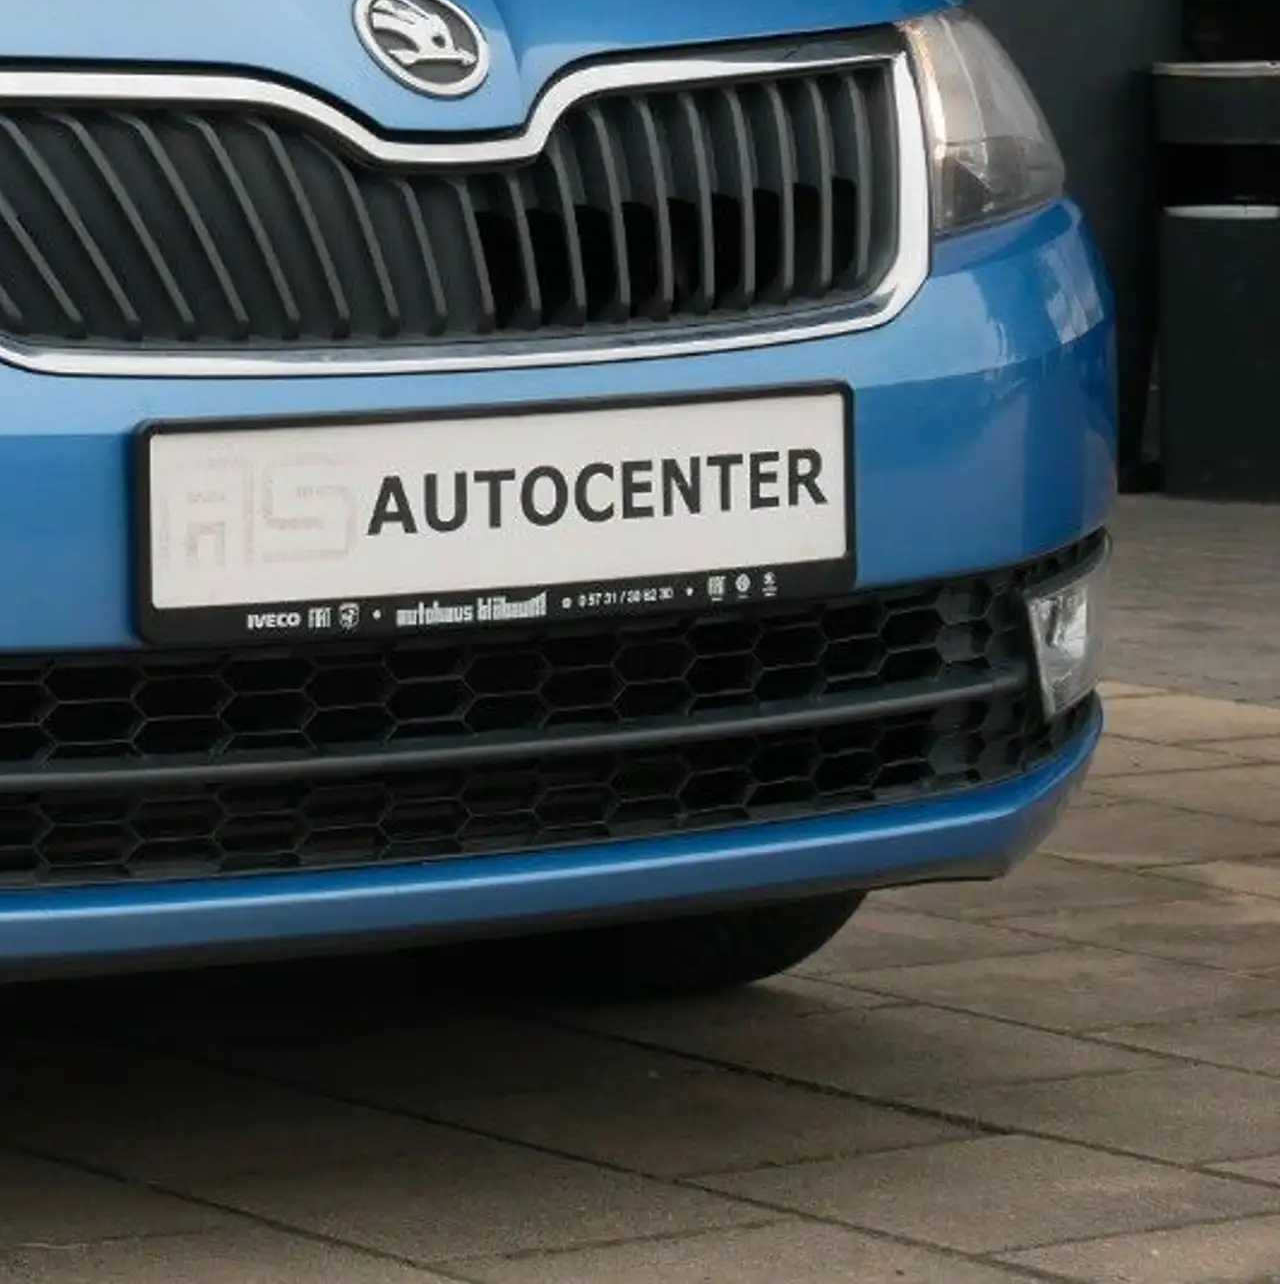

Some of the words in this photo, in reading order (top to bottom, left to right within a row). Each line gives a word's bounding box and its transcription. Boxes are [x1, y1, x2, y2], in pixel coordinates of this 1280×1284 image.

[367, 447, 829, 537] AUTOCENTER
[246, 611, 301, 630] IVECO
[395, 600, 473, 627] autohaus
